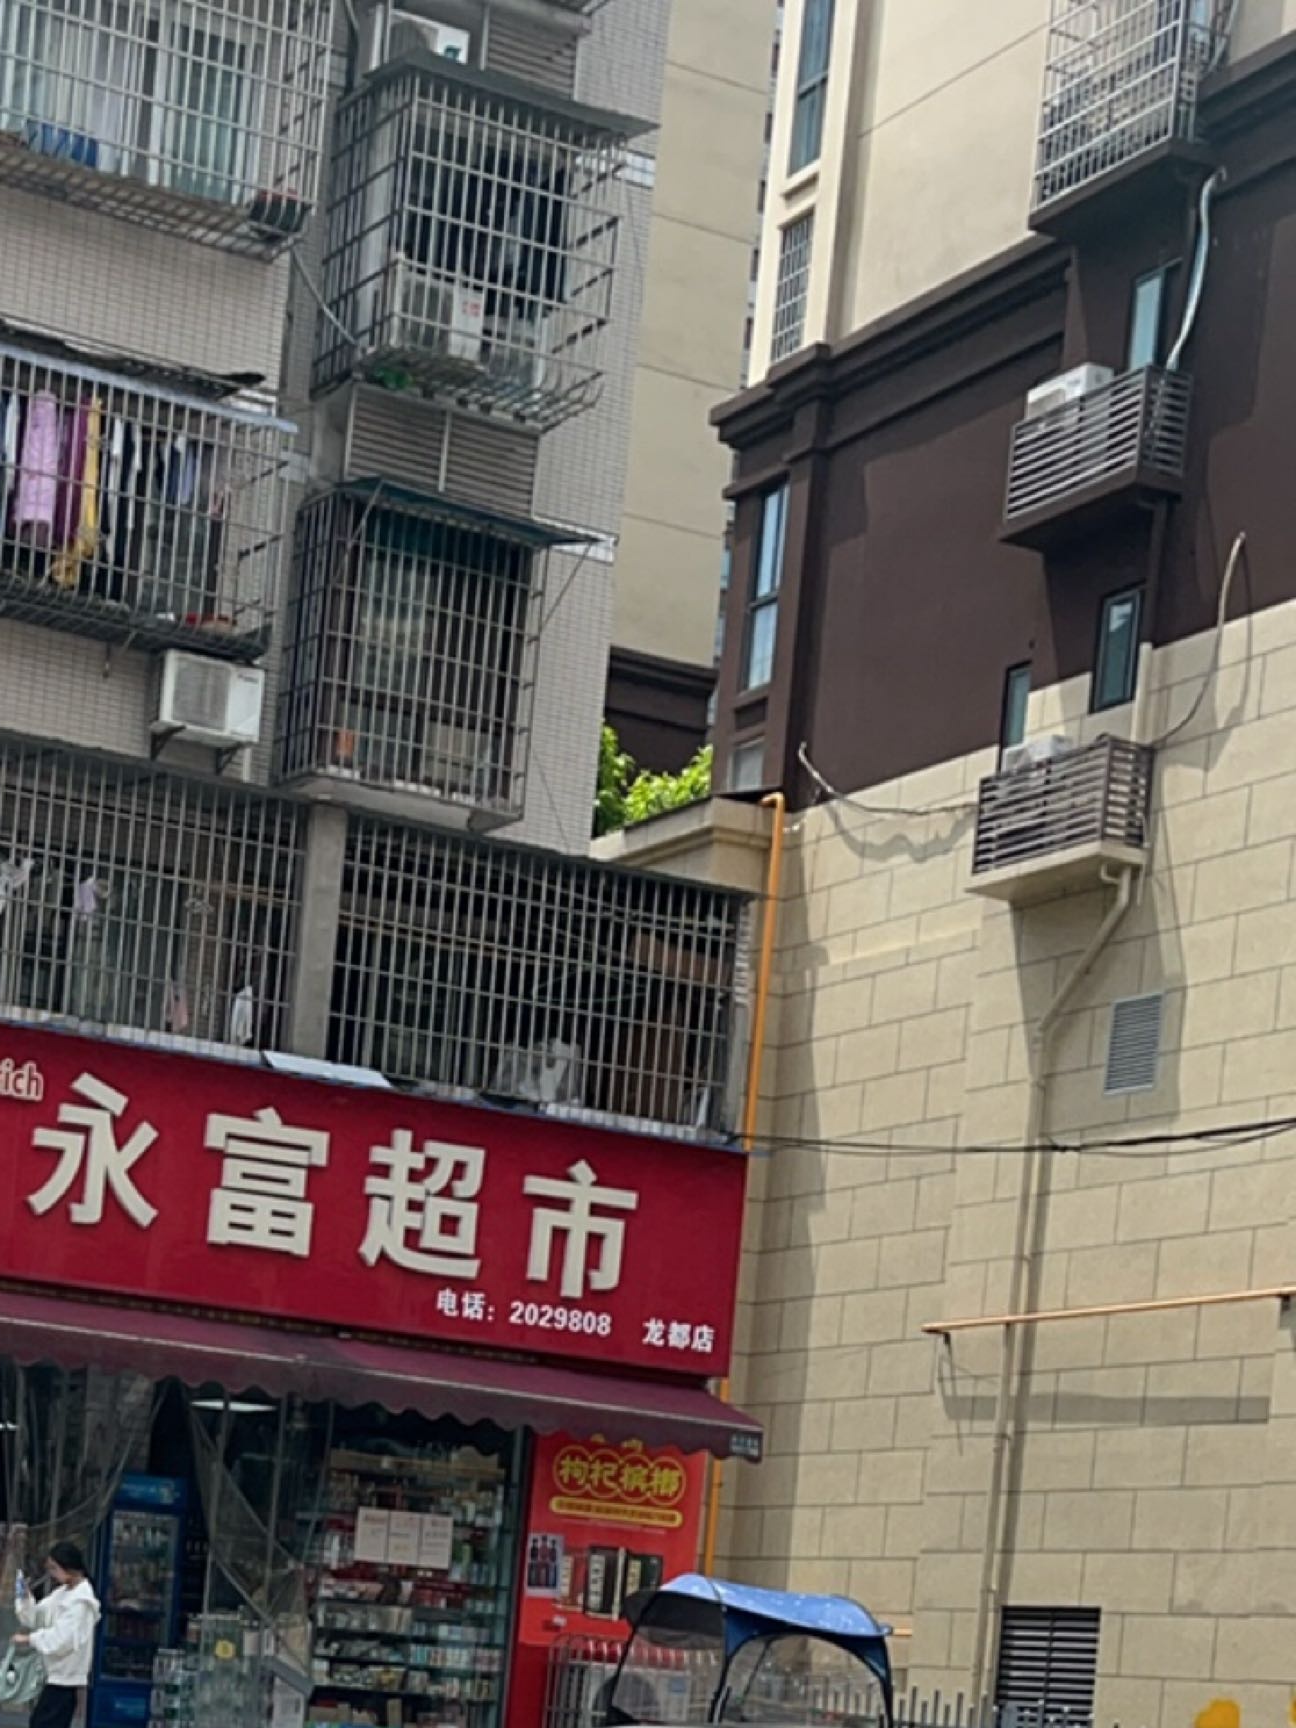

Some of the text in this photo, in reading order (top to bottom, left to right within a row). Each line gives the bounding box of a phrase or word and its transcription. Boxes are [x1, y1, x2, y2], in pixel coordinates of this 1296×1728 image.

[26, 1072, 638, 1299] 永富超市
[642, 1317, 715, 1353] 龙都店
[559, 1453, 682, 1498] 枸杞槟榔
